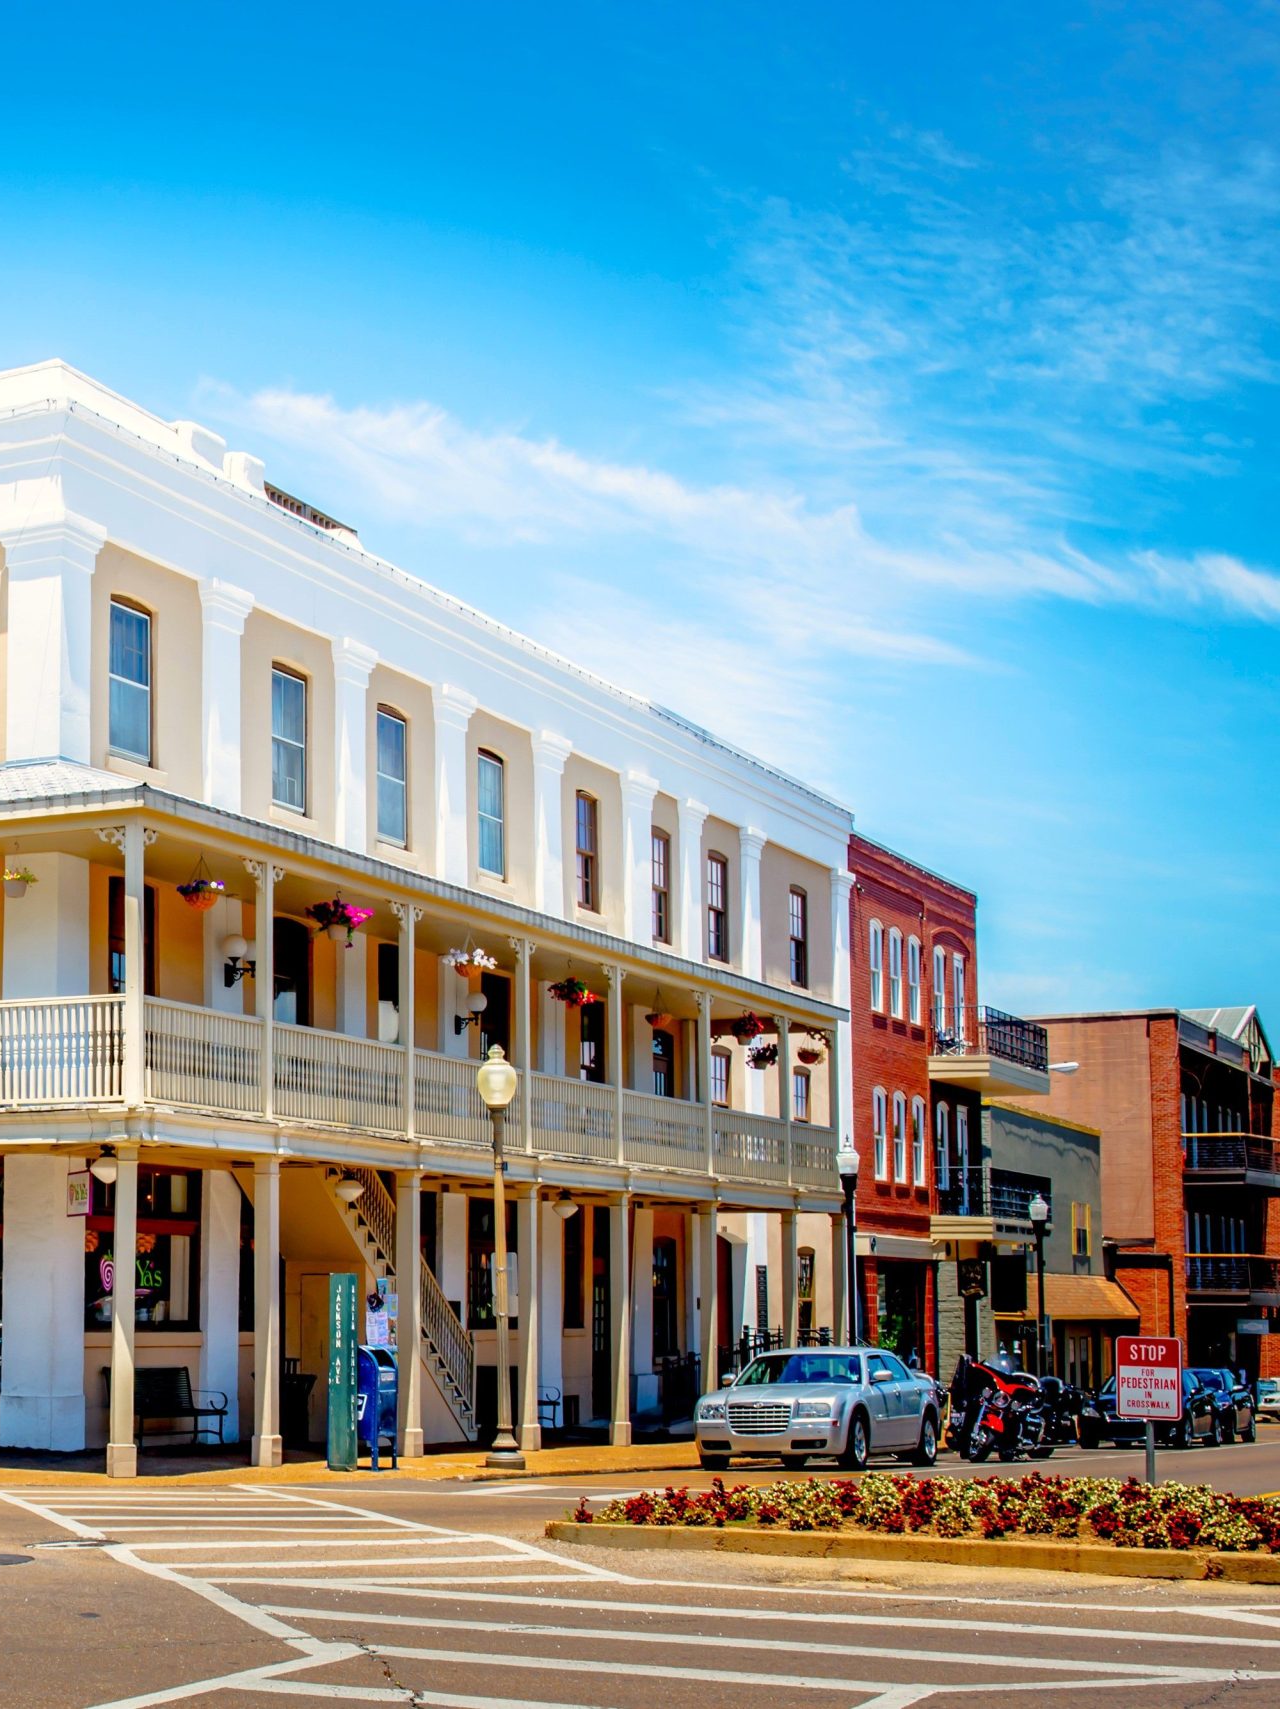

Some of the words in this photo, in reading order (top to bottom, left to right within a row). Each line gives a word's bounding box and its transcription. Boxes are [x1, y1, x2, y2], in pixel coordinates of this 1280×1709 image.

[1129, 1343, 1167, 1362] STOP
[1141, 1368, 1155, 1377] FOR
[1120, 1376, 1176, 1391] PEDESTRIAN
[1144, 1391, 1153, 1399] IN
[1126, 1399, 1170, 1409] CROSSWALK
